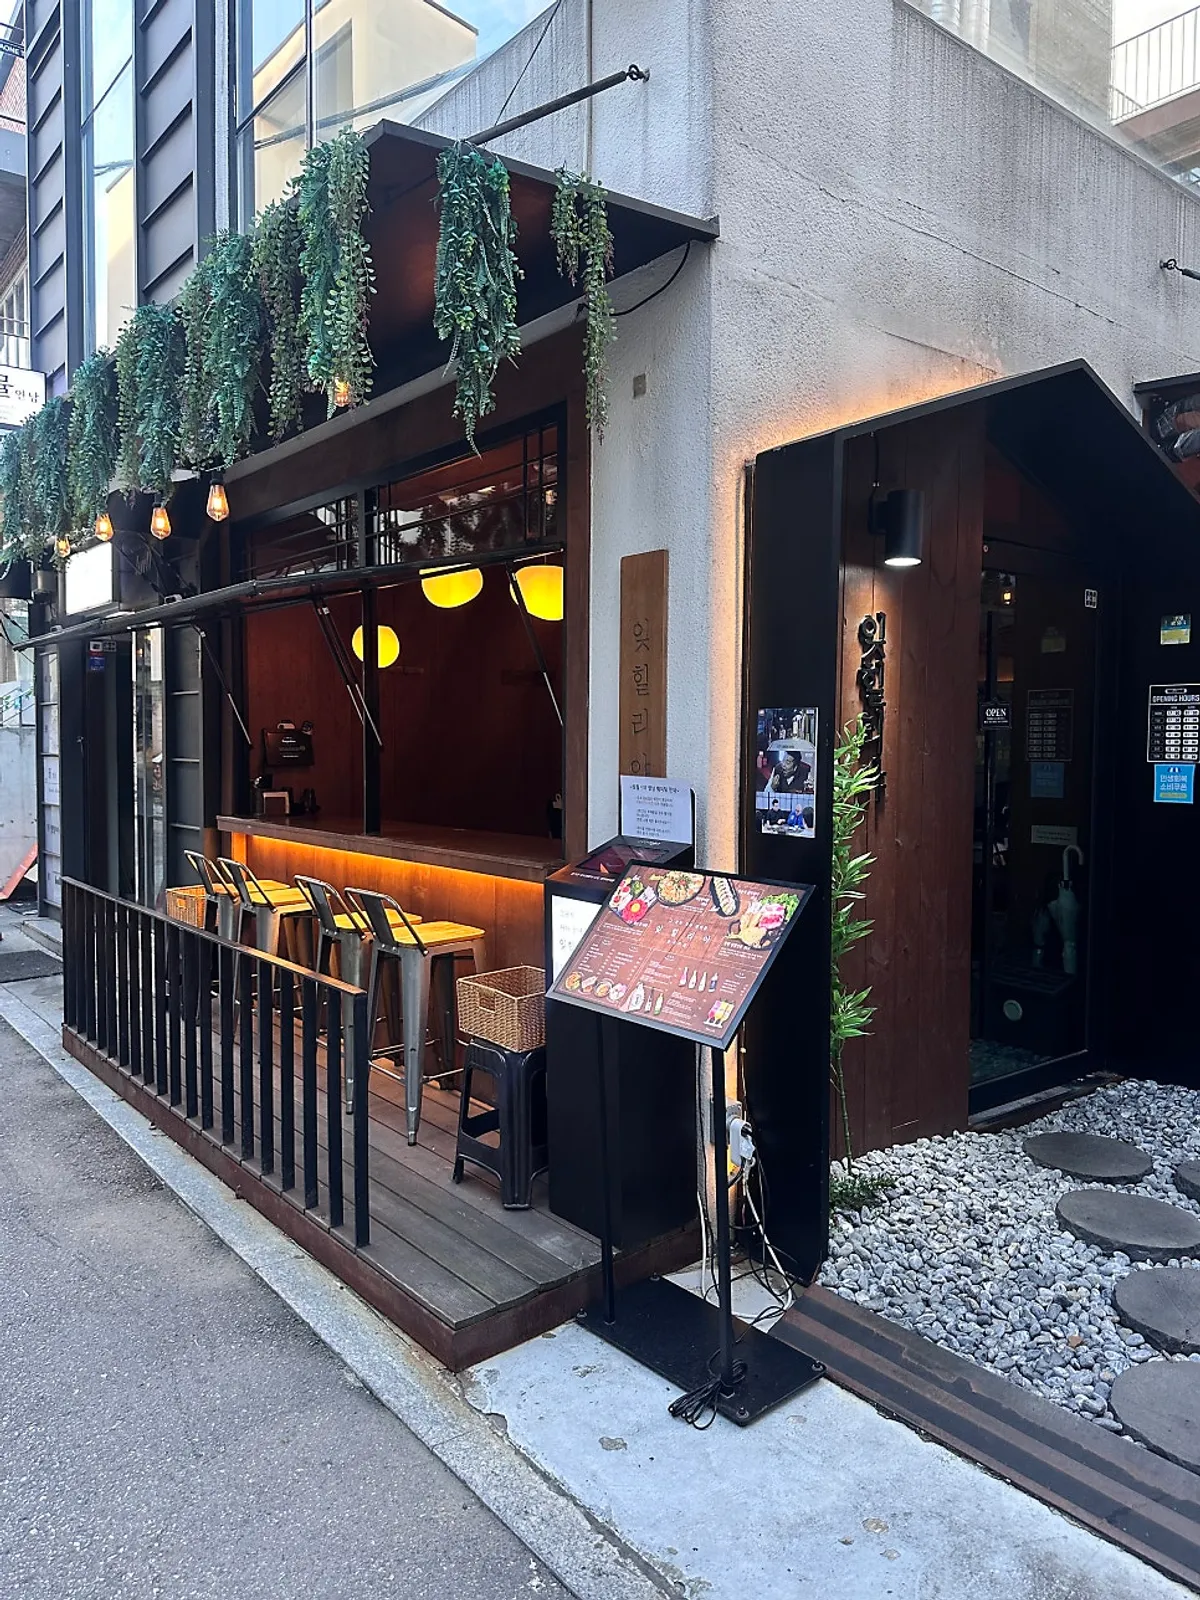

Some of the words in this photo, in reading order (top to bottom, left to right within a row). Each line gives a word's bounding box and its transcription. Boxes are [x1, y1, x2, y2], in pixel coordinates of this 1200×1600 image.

[1152, 695, 1178, 703] OPENING
[1178, 694, 1200, 702] HOURS
[985, 707, 1007, 717] OPEN
